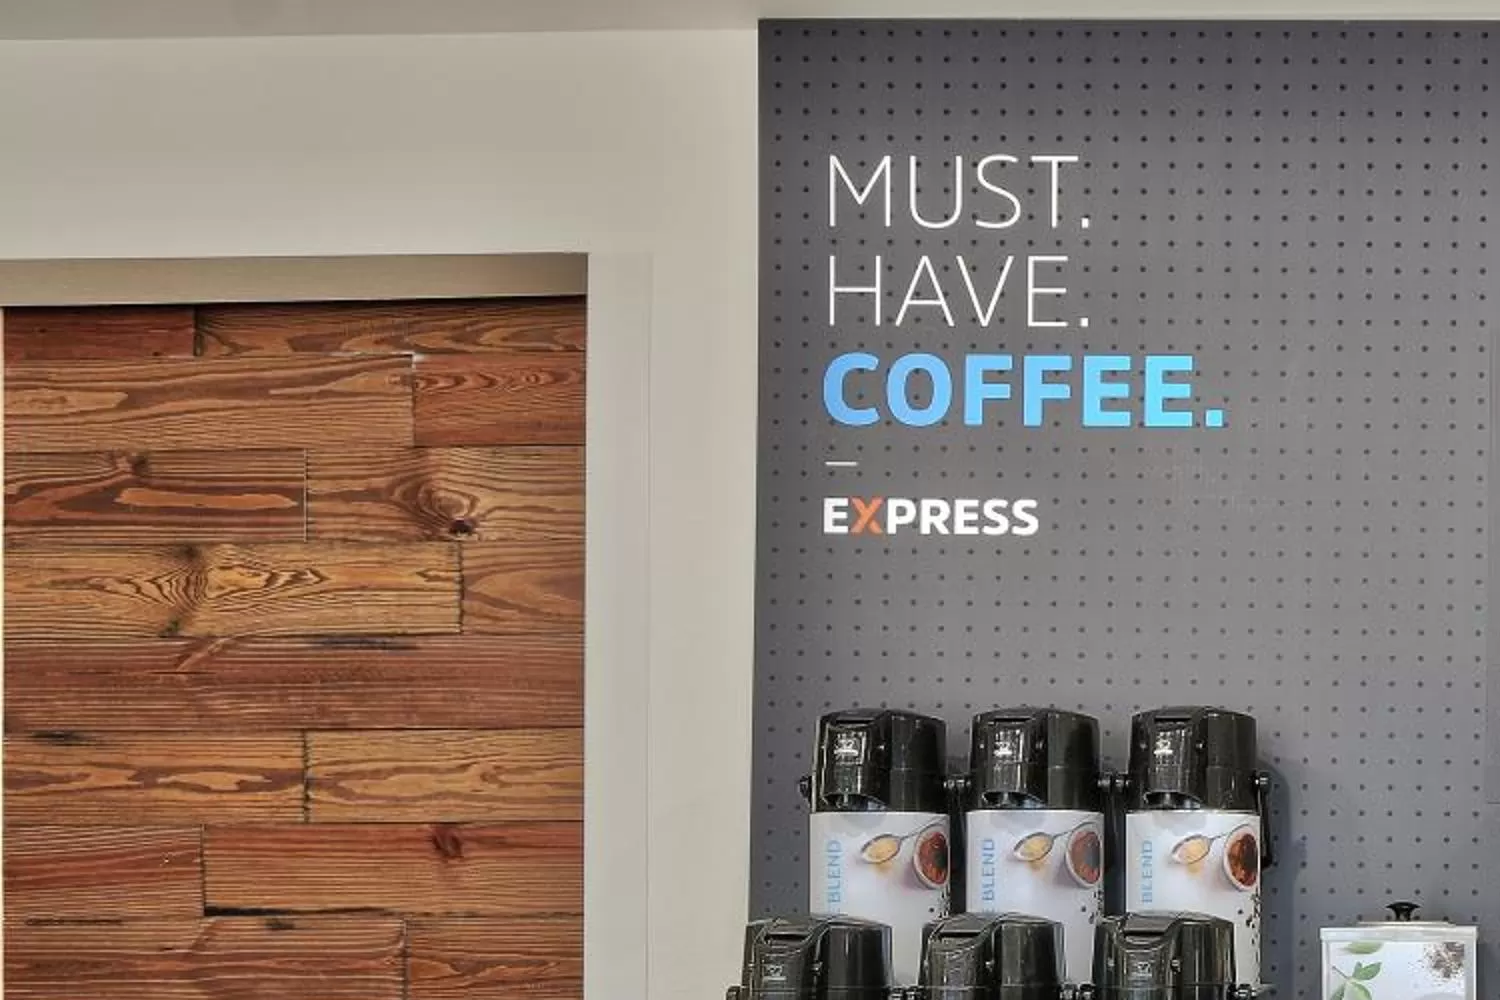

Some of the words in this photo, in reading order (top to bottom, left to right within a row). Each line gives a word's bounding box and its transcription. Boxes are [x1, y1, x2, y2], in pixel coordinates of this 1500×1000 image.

[829, 155, 1090, 228] MUST.
[829, 255, 1090, 327] HAVE.
[822, 352, 1224, 427] COFFEE.
[823, 497, 1039, 535] EXPRESS
[828, 839, 842, 903] BLEND
[981, 838, 996, 902] BLEND
